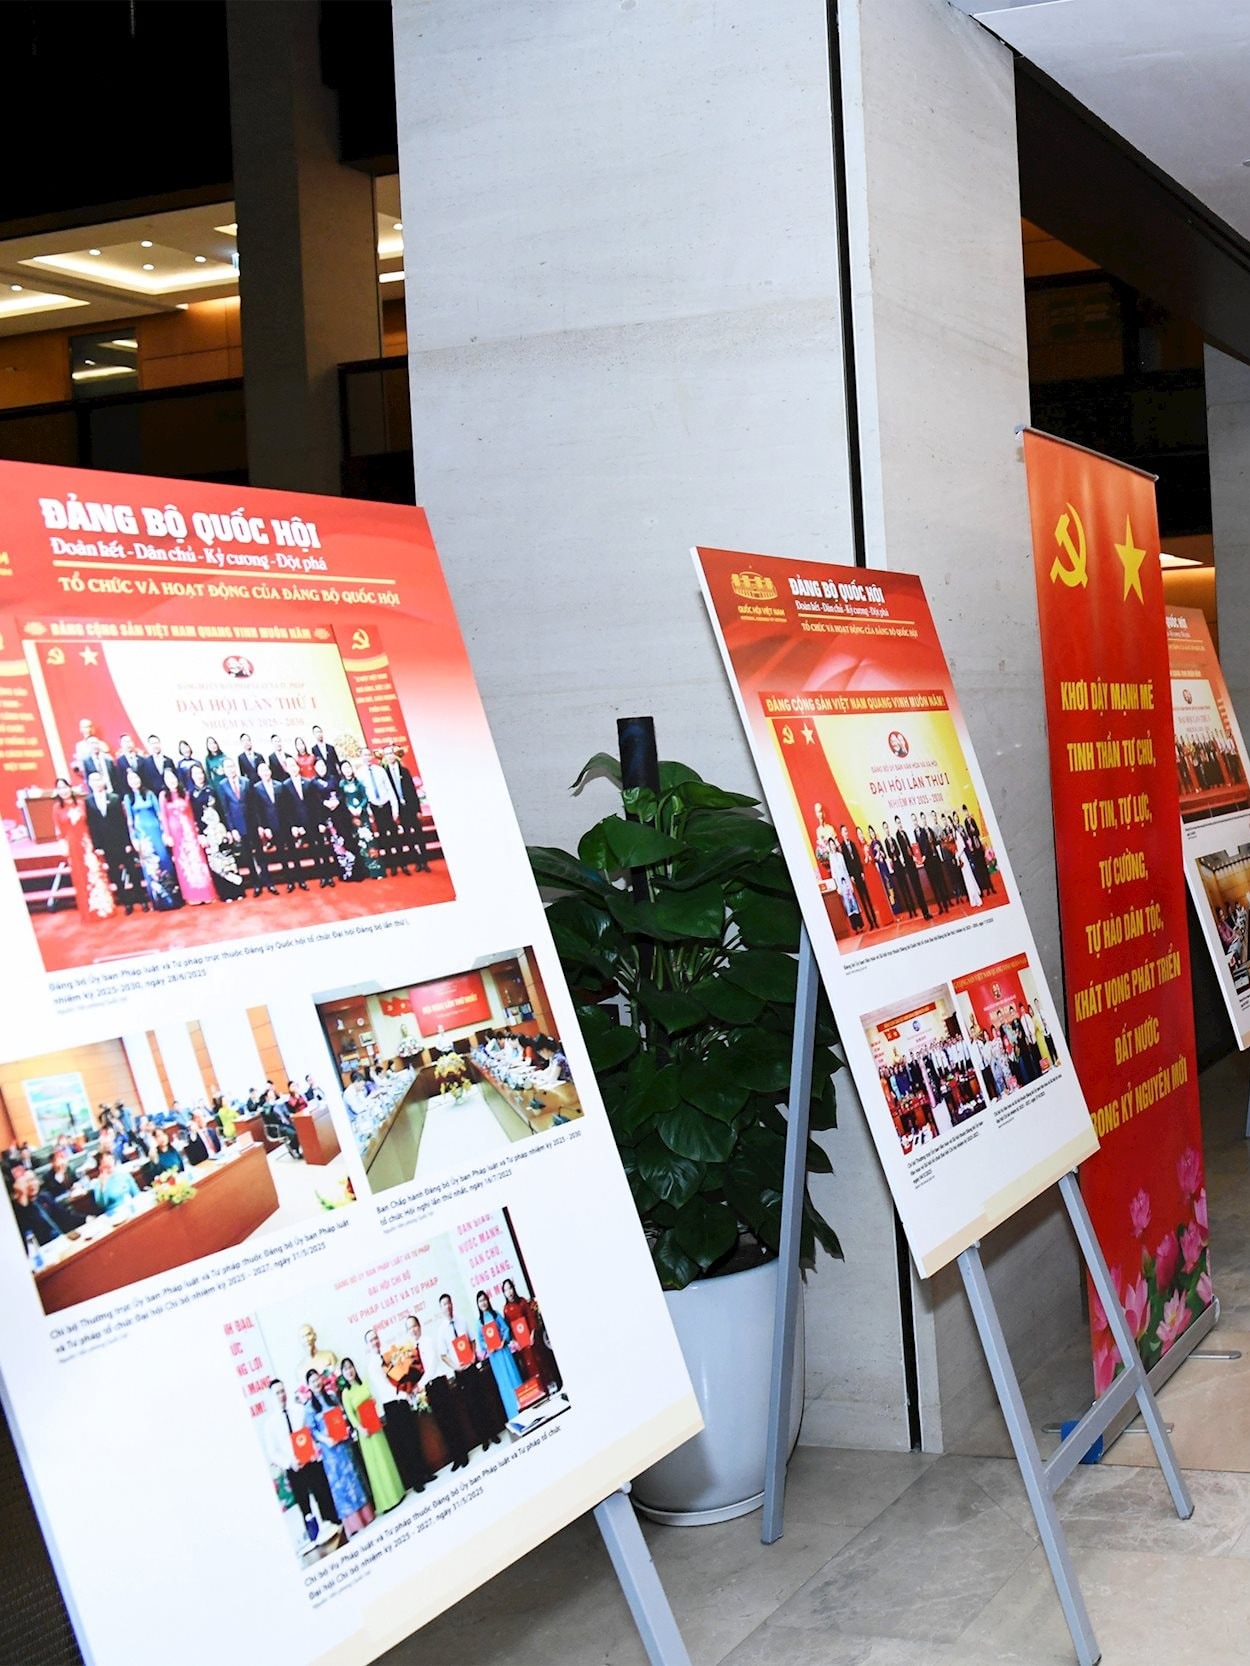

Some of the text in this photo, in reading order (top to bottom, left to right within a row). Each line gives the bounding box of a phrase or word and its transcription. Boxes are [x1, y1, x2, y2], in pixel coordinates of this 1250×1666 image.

[38, 493, 321, 552] ĐẢNG BỘ QUỐC HỘI
[58, 571, 400, 608] TỔ CHỨC VÀ HOẠT ĐỘNG CỦA ĐẢNG BỘ QUỐC HỘI
[788, 575, 885, 606] ĐẢNG BỘ QUỐC HỘI
[766, 693, 946, 715] ĐẢNG CỘNG SẢN VIỆT NAM QUANG VINH MUÔN NĂM!
[1060, 677, 1154, 716] KHƠI DẬY MẠNH MẼ
[1067, 742, 1094, 772] TINH
[1122, 738, 1135, 772] TỰ
[1136, 730, 1156, 768] CHỦ,
[1082, 800, 1098, 836] TỰ
[1099, 800, 1118, 830] TIN,
[1118, 794, 1132, 830] TỰ
[1133, 792, 1152, 827] LỰC,
[1099, 848, 1148, 894] TỰ CƯỜNG,
[1086, 900, 1164, 958] TỰ HÀO DÂN TỘC,
[1074, 943, 1182, 1022] KHÁT VỌNG PHÁT TRIỂN
[1114, 1016, 1160, 1066] ĐẤT NƯỚC
[1135, 1064, 1170, 1110] NGUYÊN
[1170, 1054, 1188, 1090] MỚI
